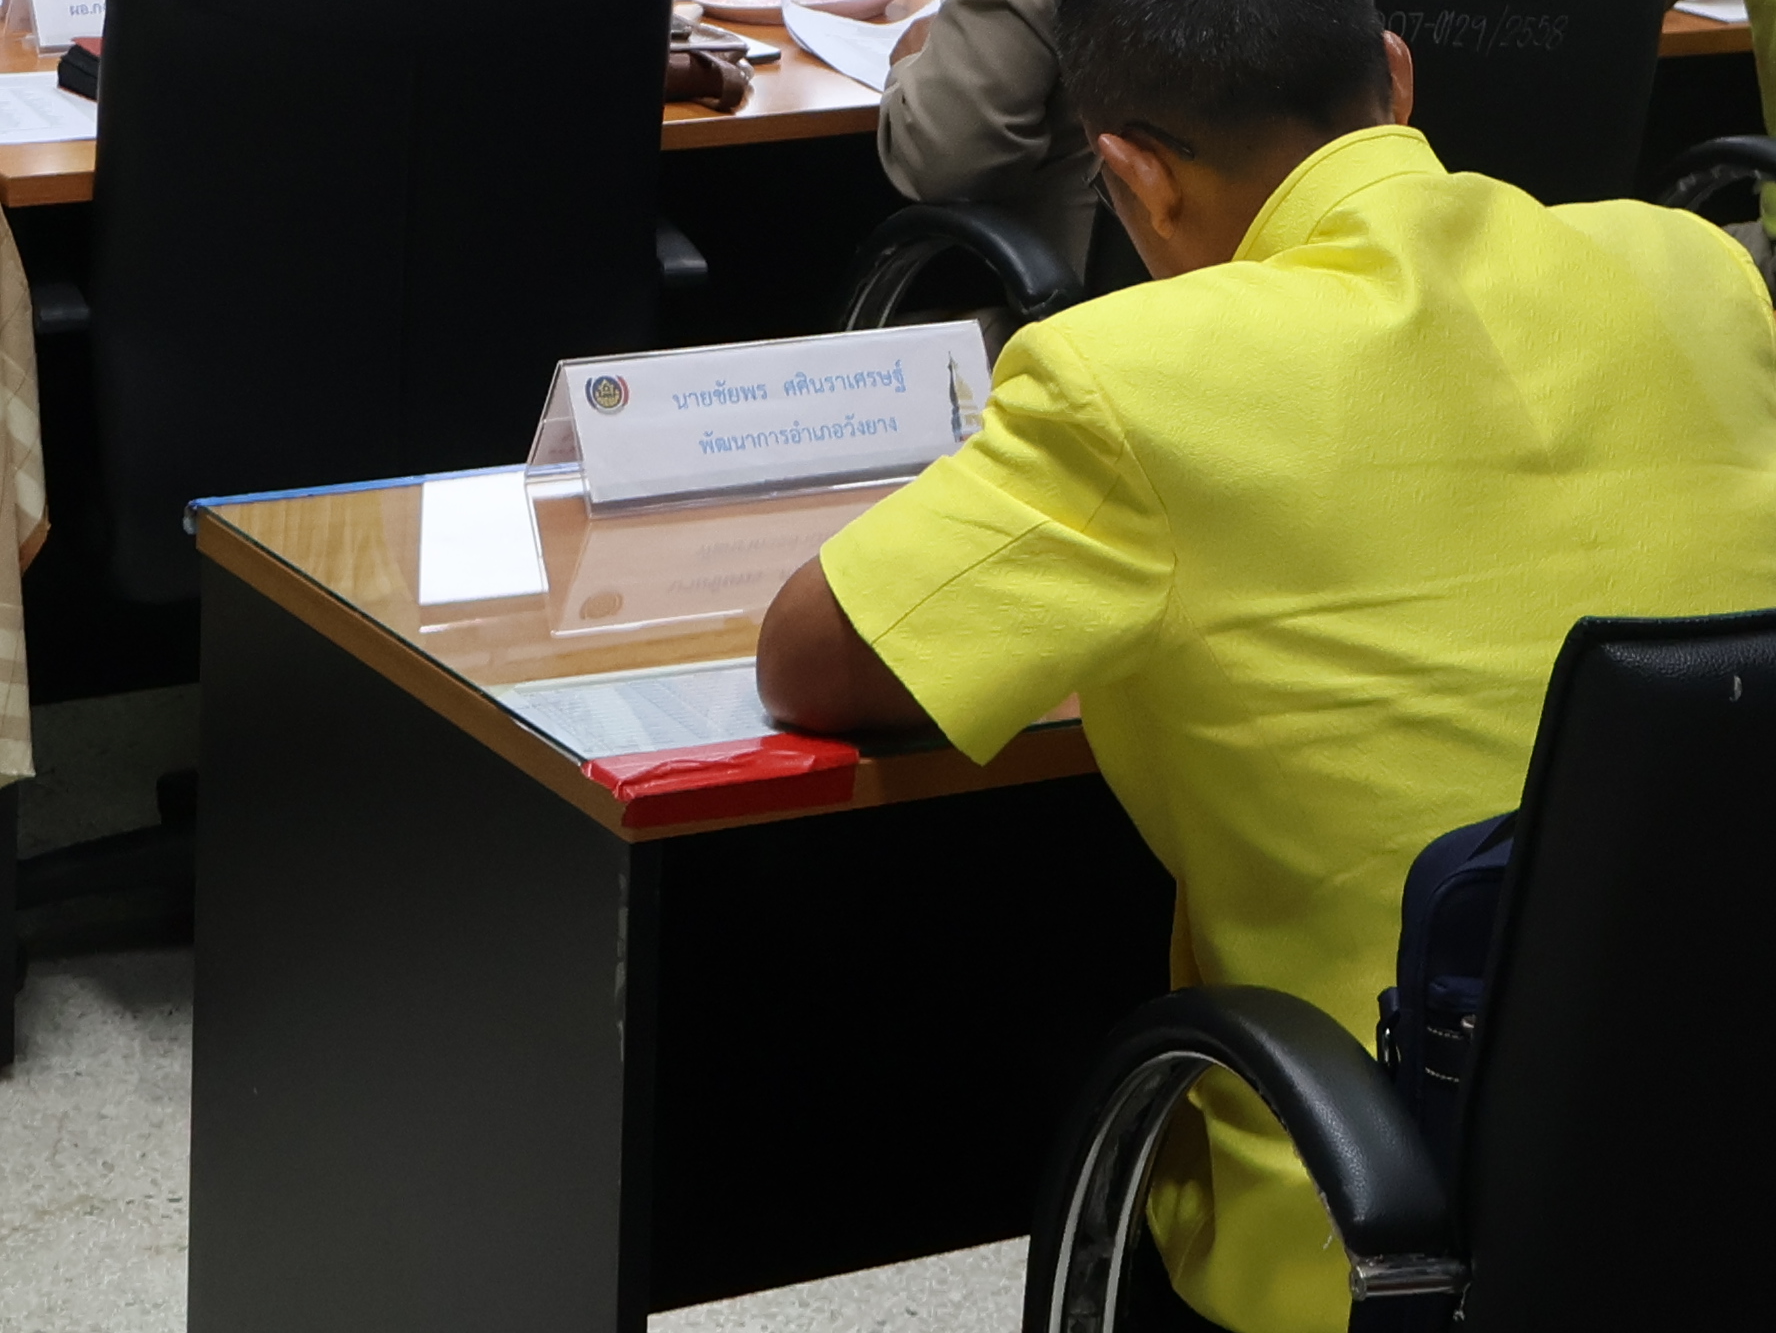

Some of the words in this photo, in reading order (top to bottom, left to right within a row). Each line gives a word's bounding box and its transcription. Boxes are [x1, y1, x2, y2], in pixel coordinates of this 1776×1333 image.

[673, 380, 768, 410] นายชัยพร
[699, 413, 898, 454] พัฒนาการอำเภอวังยาง
